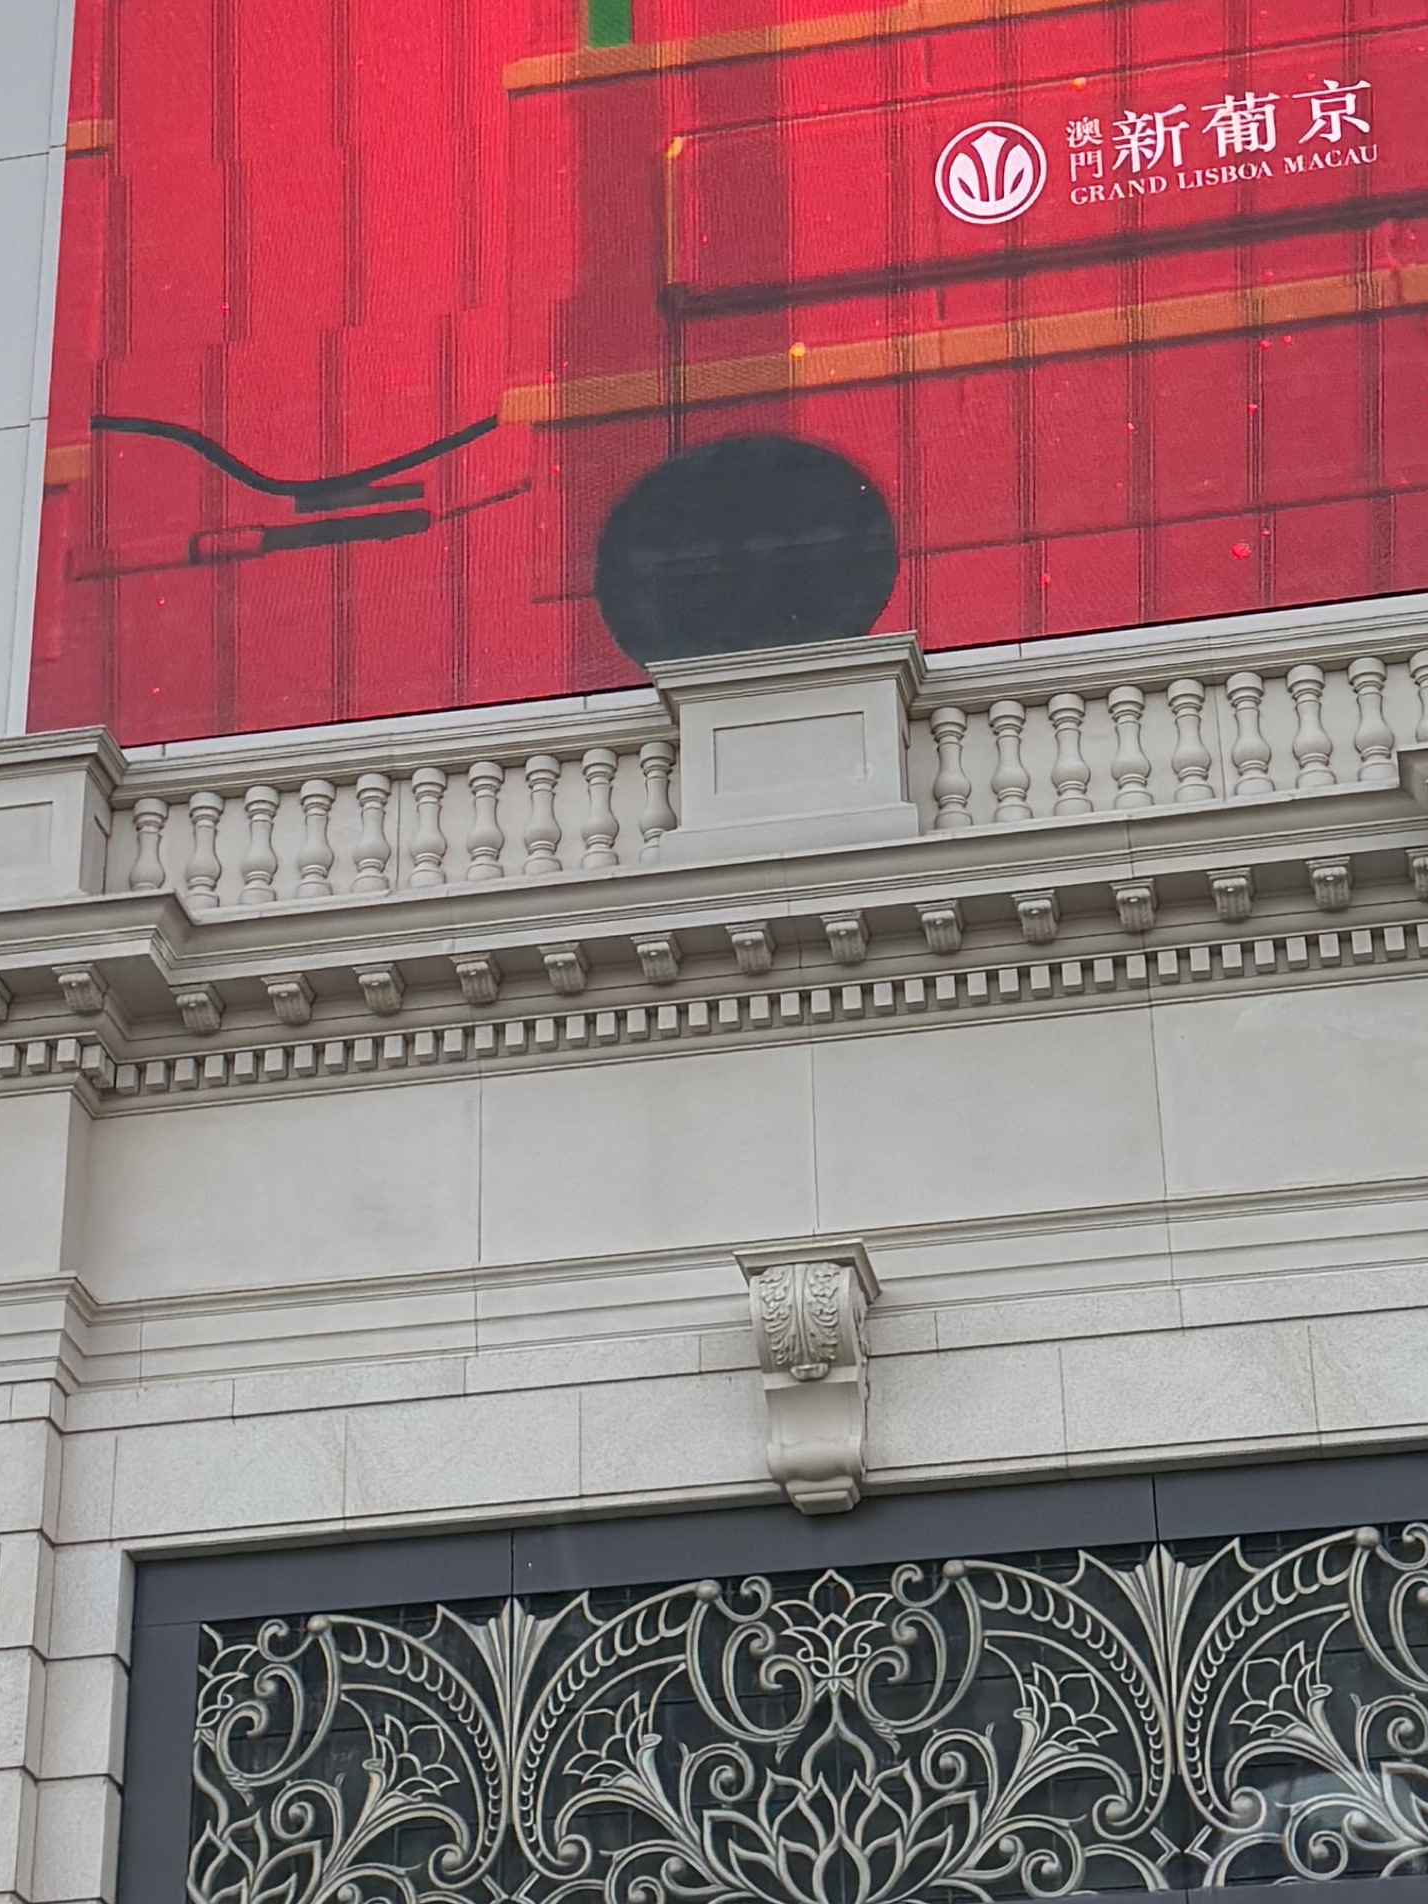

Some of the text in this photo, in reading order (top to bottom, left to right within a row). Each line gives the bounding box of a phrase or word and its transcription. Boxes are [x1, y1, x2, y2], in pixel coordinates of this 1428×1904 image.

[1111, 79, 1372, 173] 新葡京
[1069, 143, 1379, 206] GRAND LISBOA MACAU
